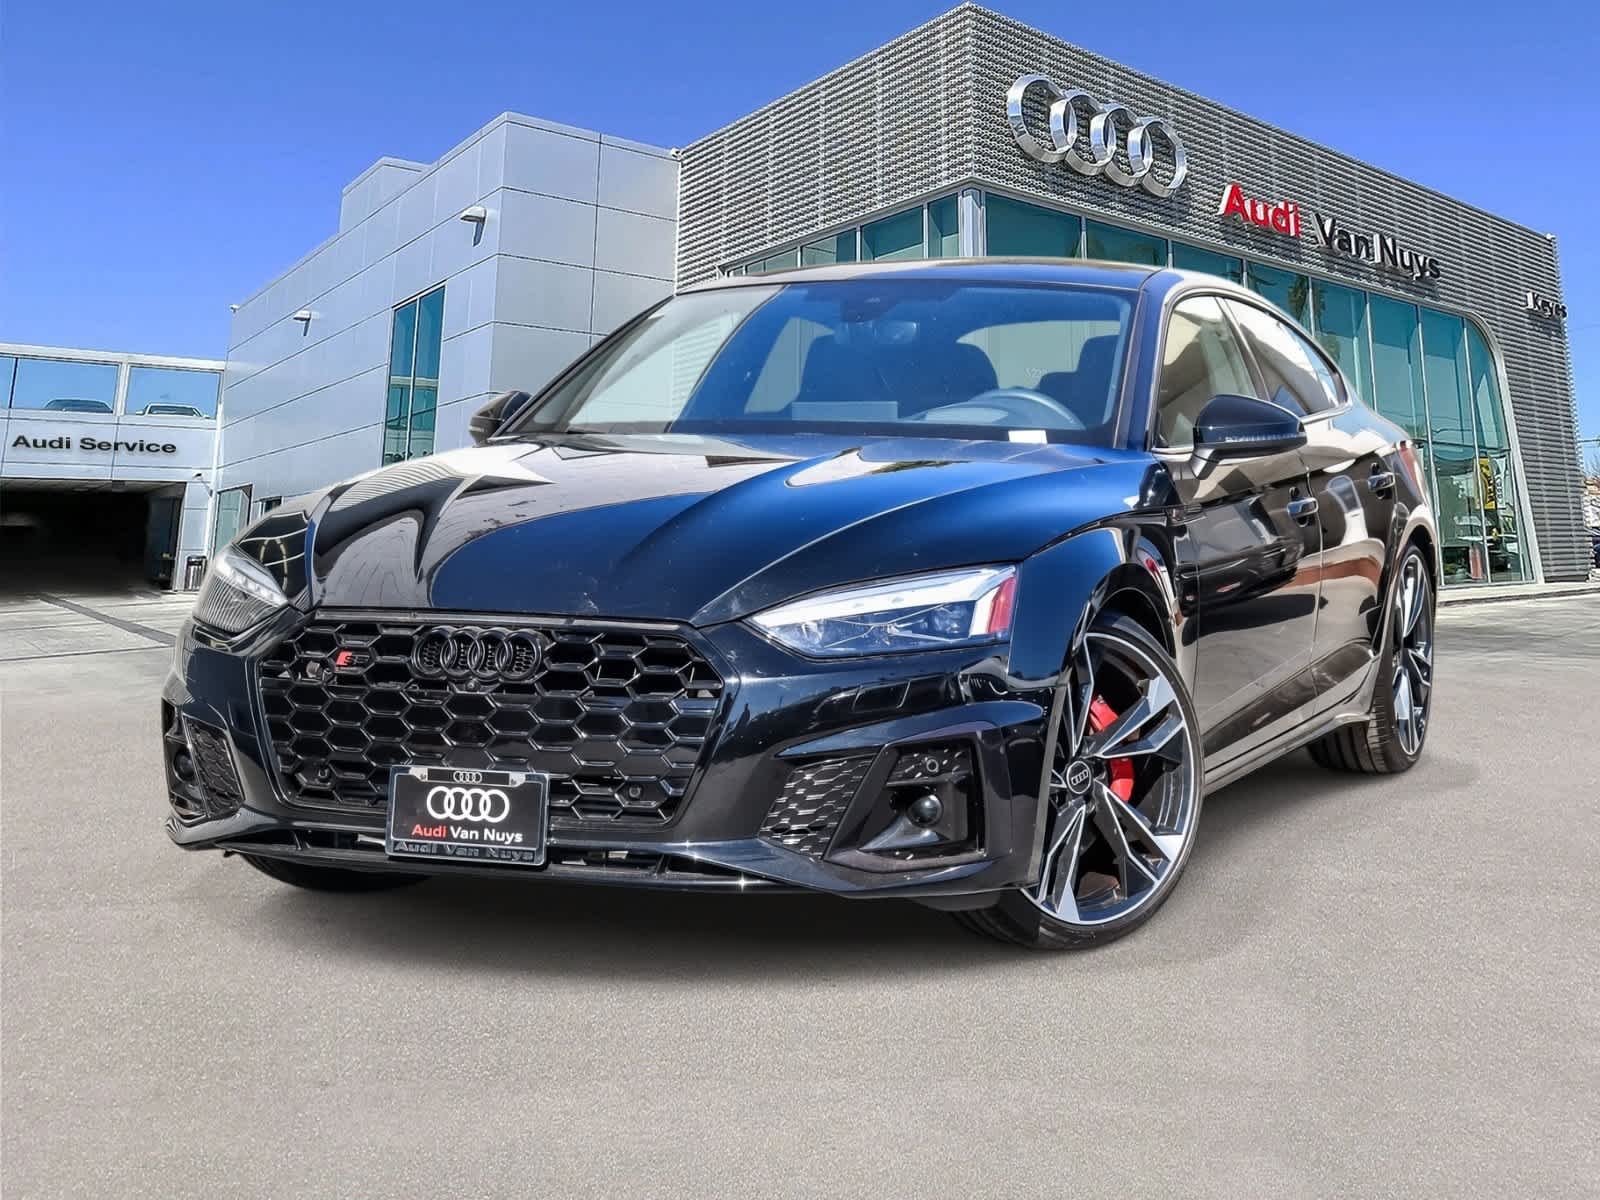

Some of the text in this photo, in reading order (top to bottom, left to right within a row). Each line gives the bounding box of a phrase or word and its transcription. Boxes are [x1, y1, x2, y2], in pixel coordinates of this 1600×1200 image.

[1218, 183, 1441, 280] Audi Van Nuys
[12, 435, 177, 454] Audi Service
[411, 824, 524, 845] Audi Van Nuys
[394, 841, 534, 862] Audi Van Nuys
